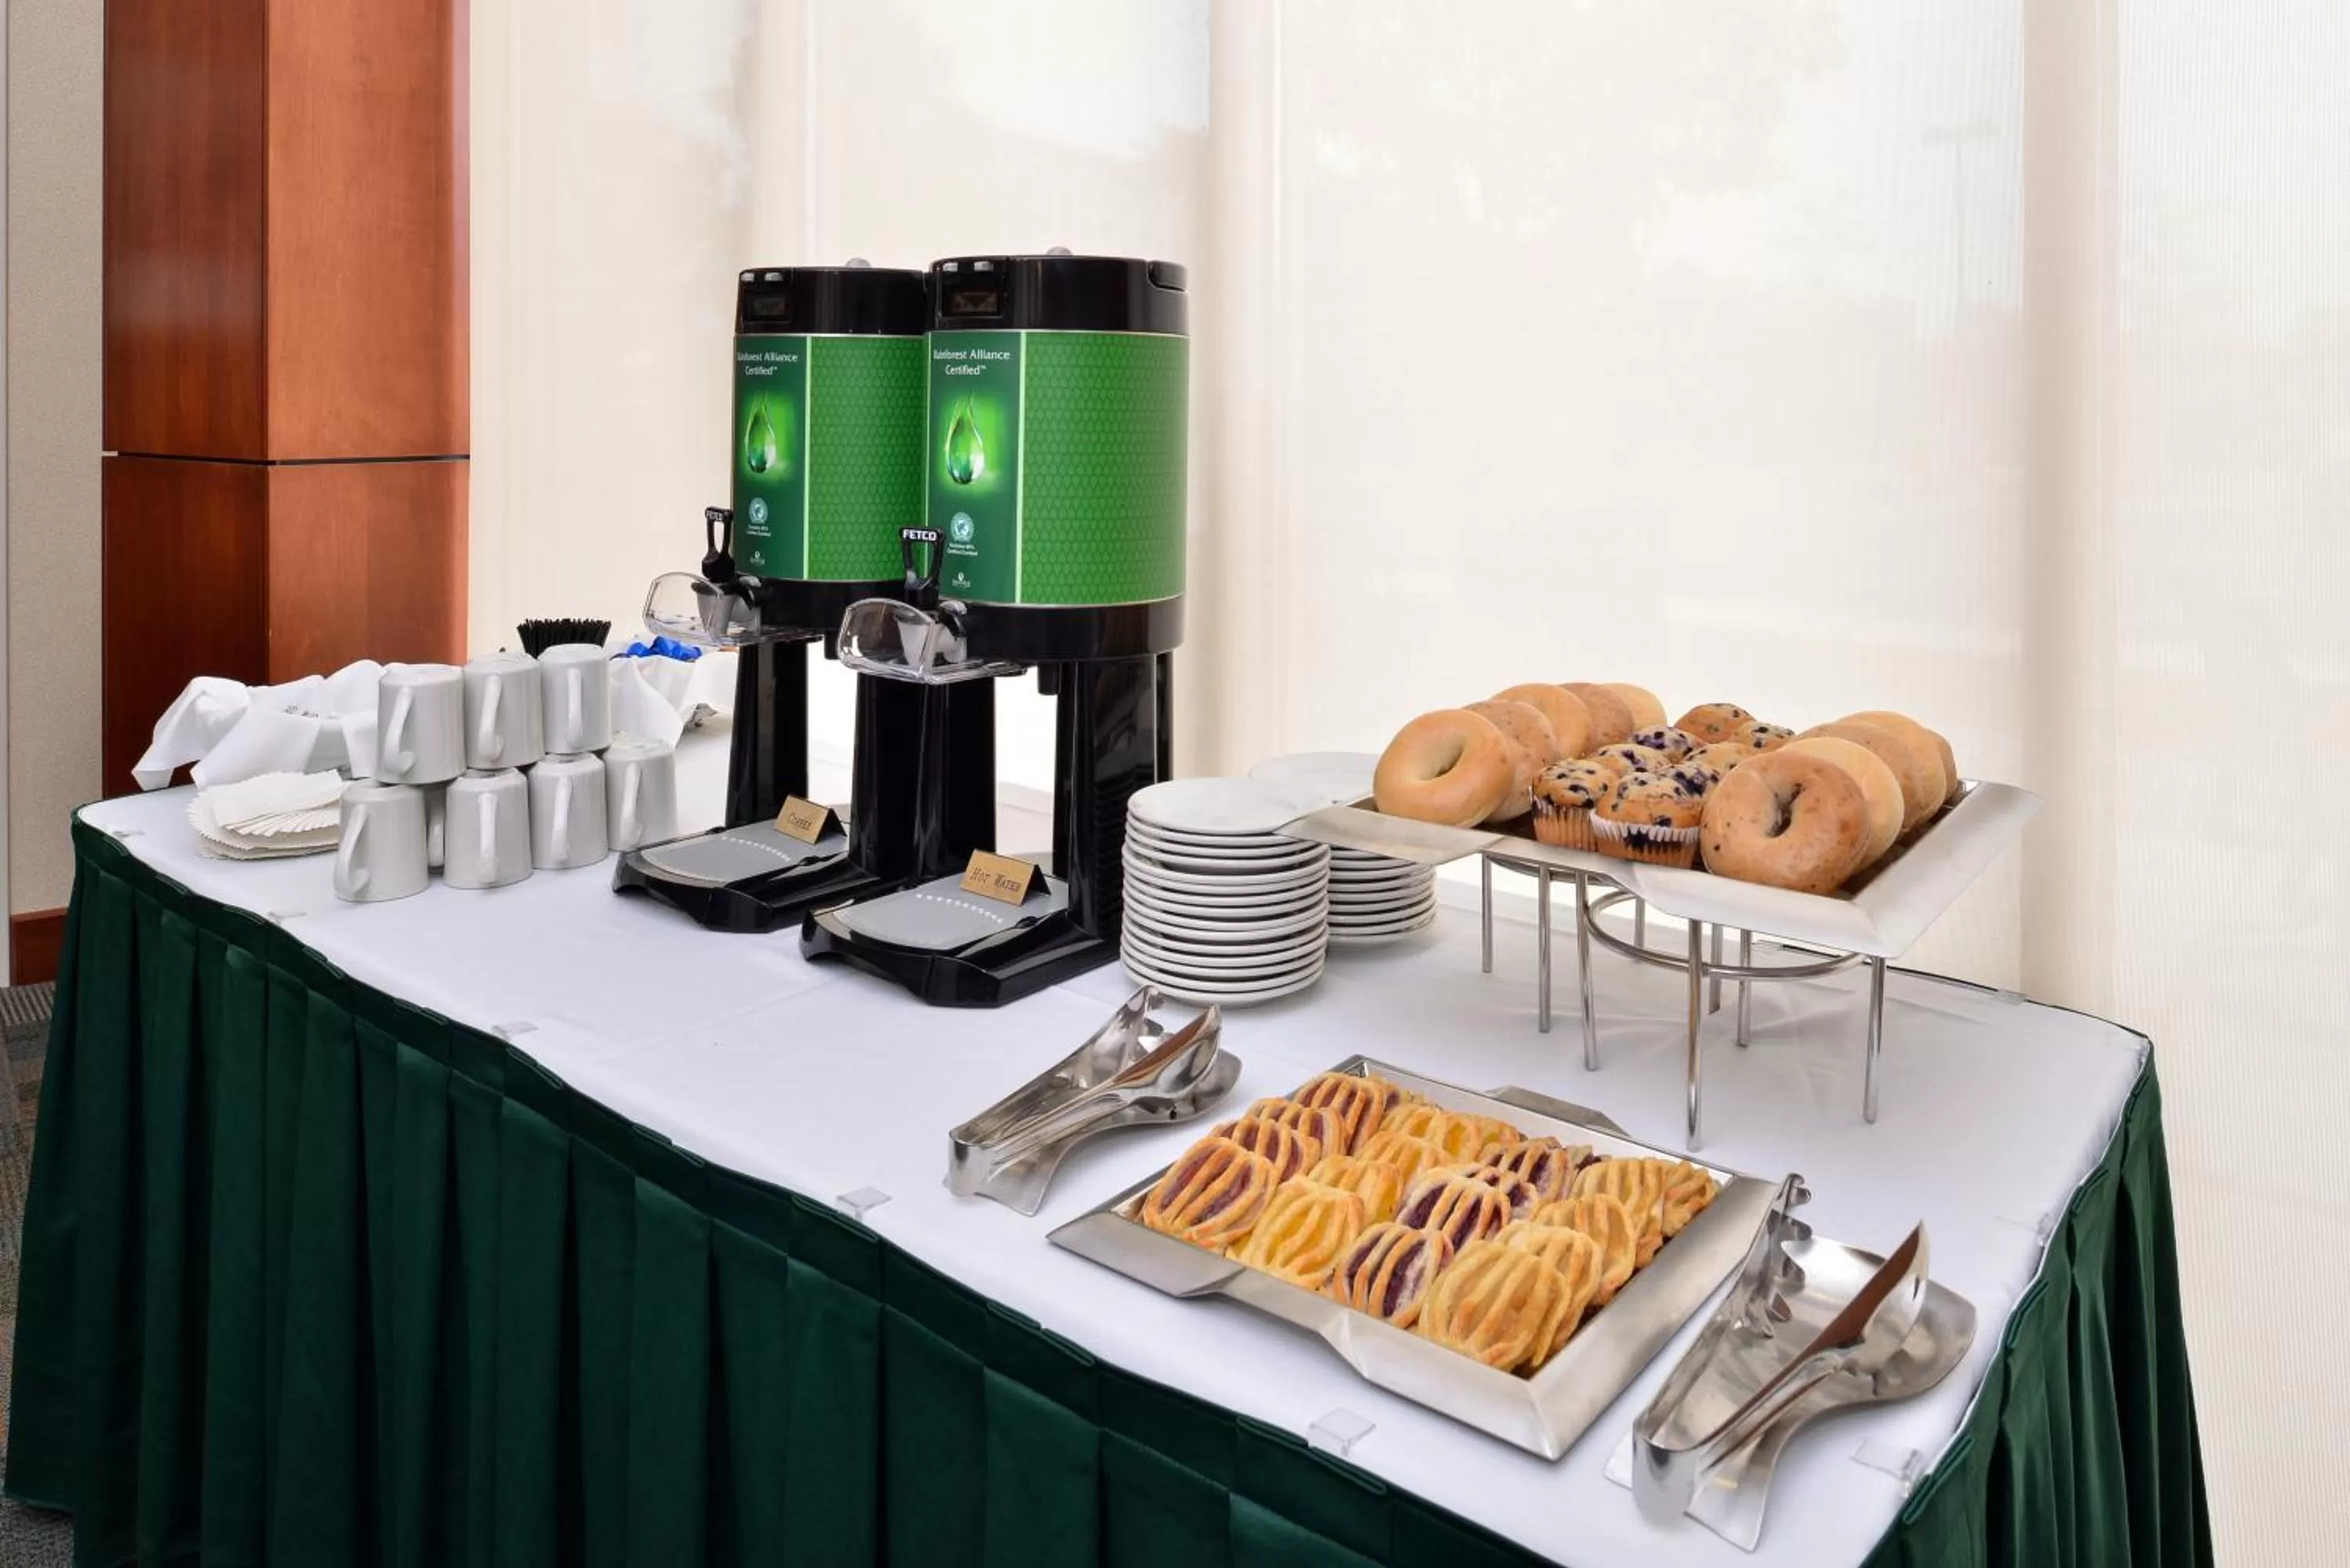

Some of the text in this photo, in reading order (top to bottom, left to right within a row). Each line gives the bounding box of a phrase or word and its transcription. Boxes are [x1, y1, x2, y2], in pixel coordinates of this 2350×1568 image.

[764, 351, 798, 362] Alliance
[970, 349, 1010, 359] Alliance
[902, 529, 938, 541] FETCO
